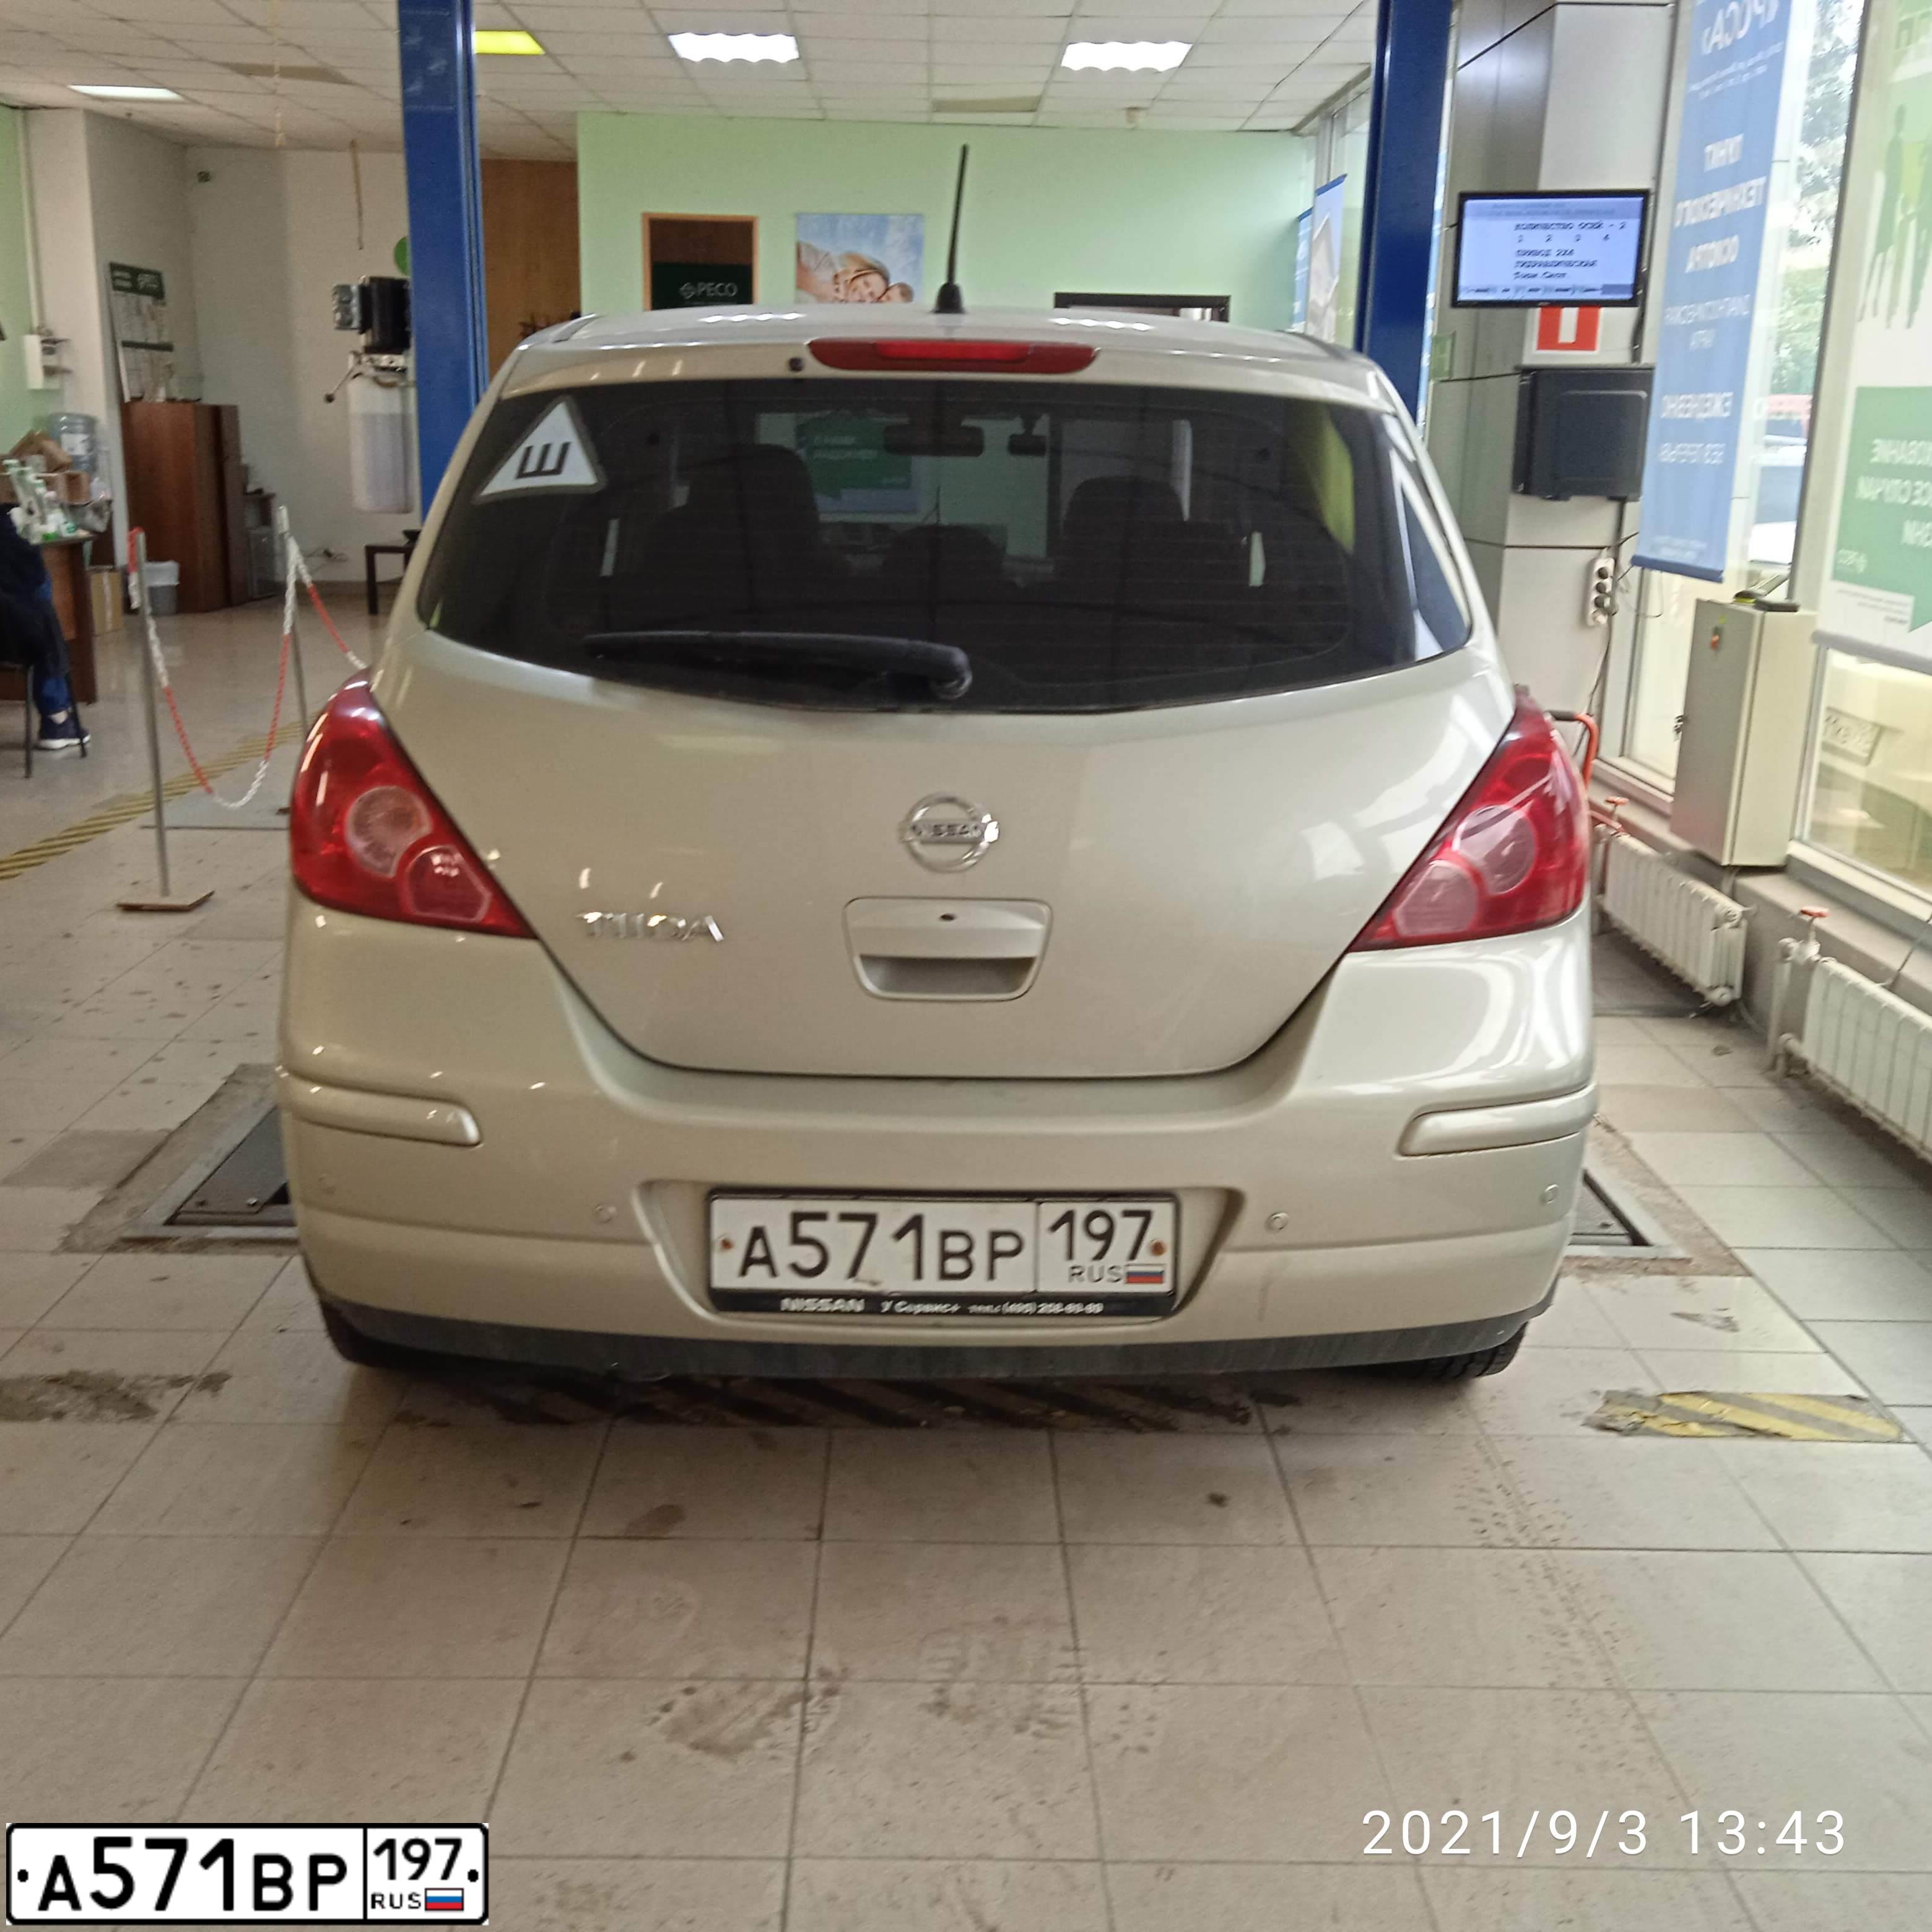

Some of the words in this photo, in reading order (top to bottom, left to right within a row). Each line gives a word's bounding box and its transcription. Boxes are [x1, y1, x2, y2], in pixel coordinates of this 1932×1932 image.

[738, 1211, 1025, 1282] А571ВР
[1049, 1209, 1154, 1261] 197
[1068, 1264, 1121, 1284] RUS
[780, 1298, 865, 1313] NISSAN
